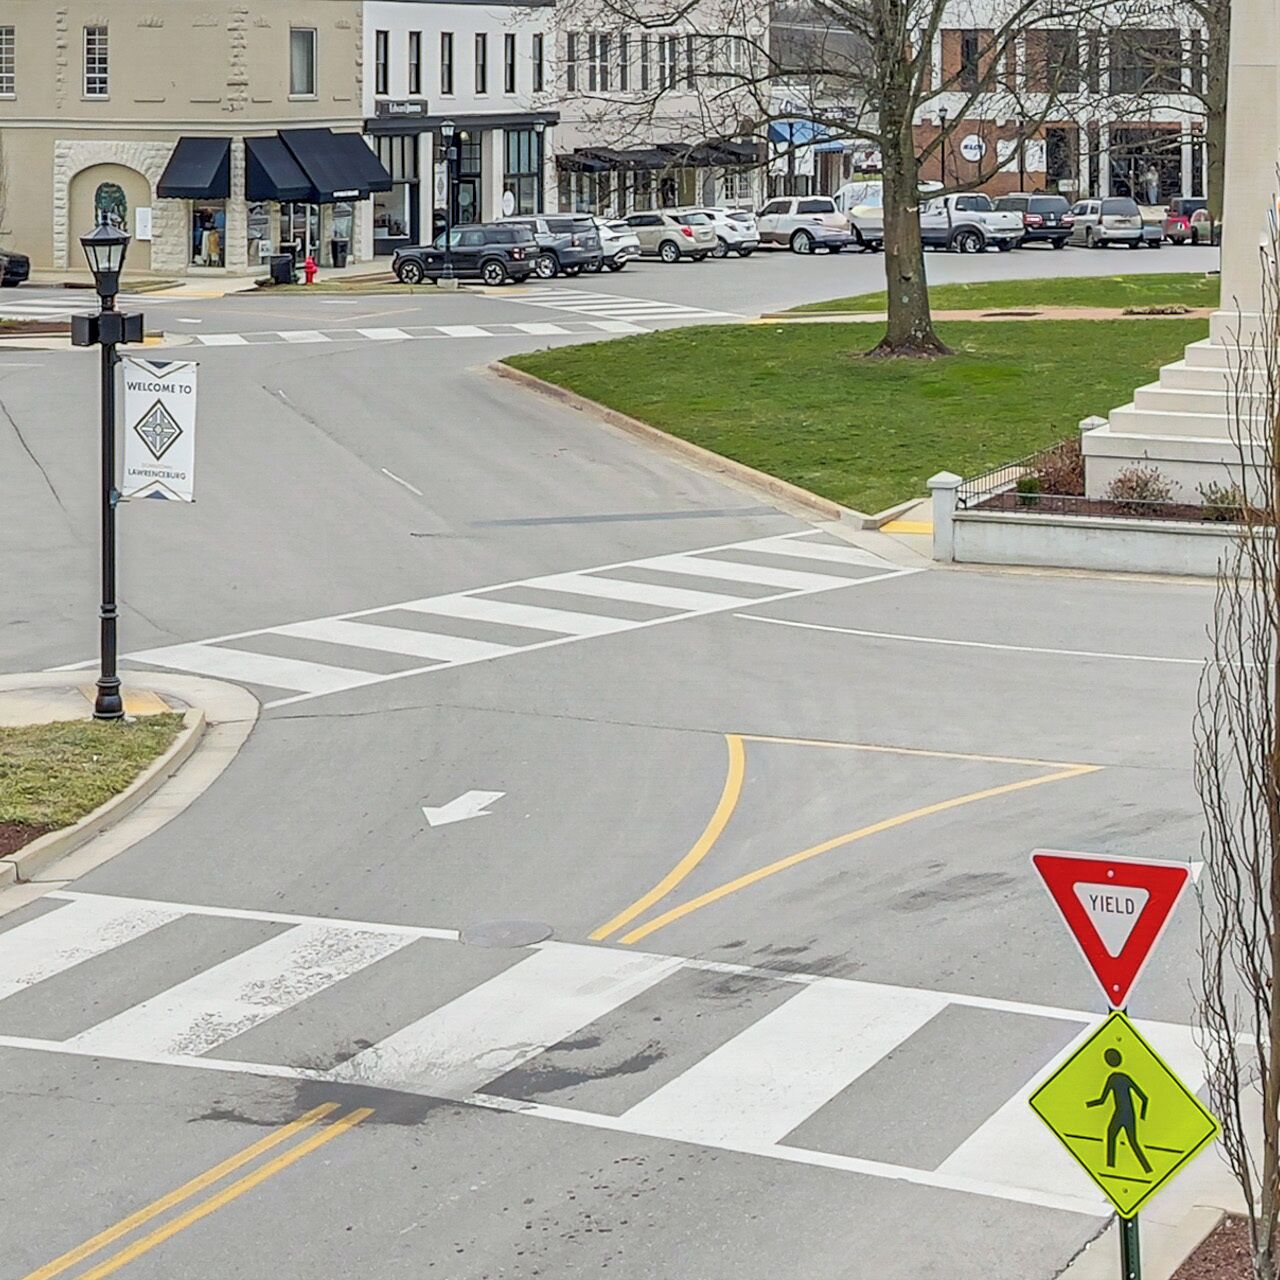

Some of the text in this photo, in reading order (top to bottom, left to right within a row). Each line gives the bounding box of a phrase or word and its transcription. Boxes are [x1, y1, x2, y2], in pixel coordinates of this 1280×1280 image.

[127, 381, 192, 394] WELCOME TO
[128, 468, 186, 480] LAWRENCEBURG
[1089, 894, 1135, 915] YIELD
